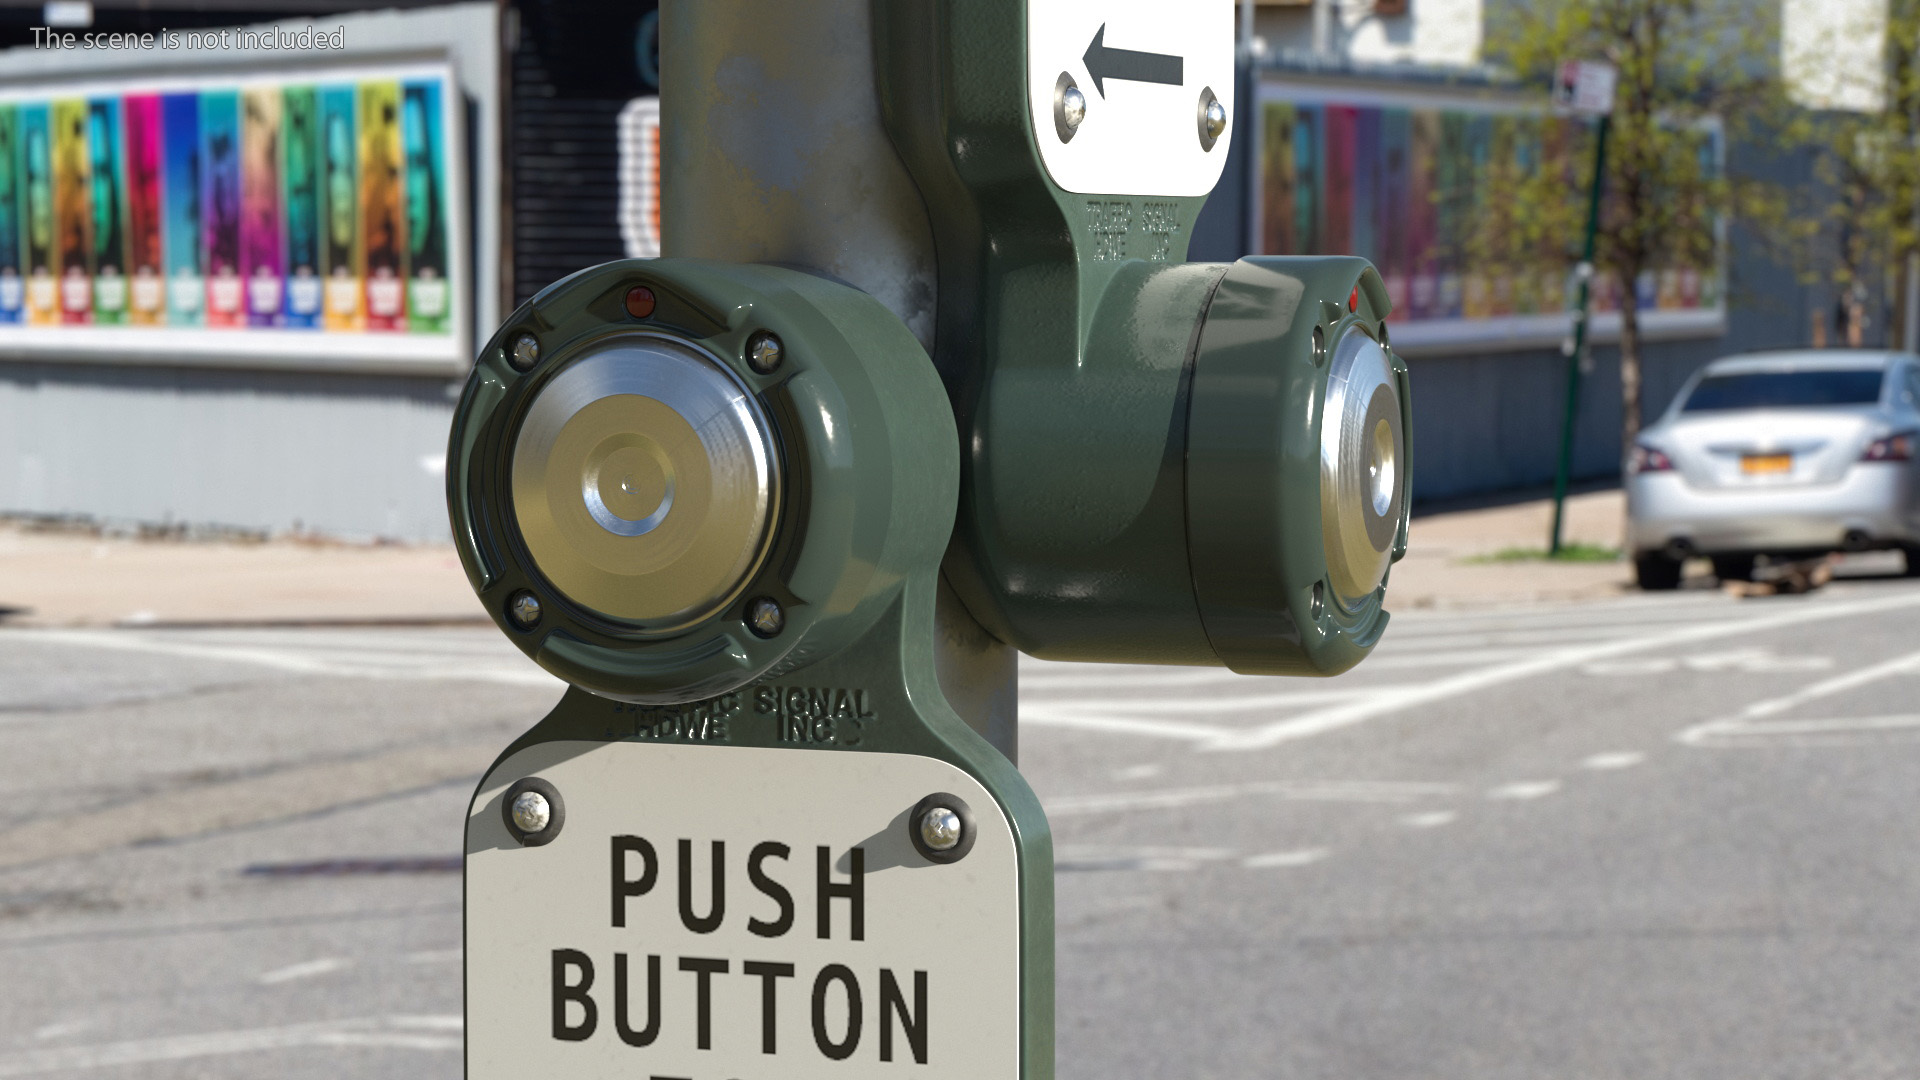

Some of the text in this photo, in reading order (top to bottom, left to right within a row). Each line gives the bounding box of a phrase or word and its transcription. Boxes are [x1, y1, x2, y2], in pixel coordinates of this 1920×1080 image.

[634, 711, 732, 742] HDWE
[754, 685, 878, 720] SIGNAL
[610, 834, 865, 941] PUSH
[551, 948, 928, 1065] BUTTON
